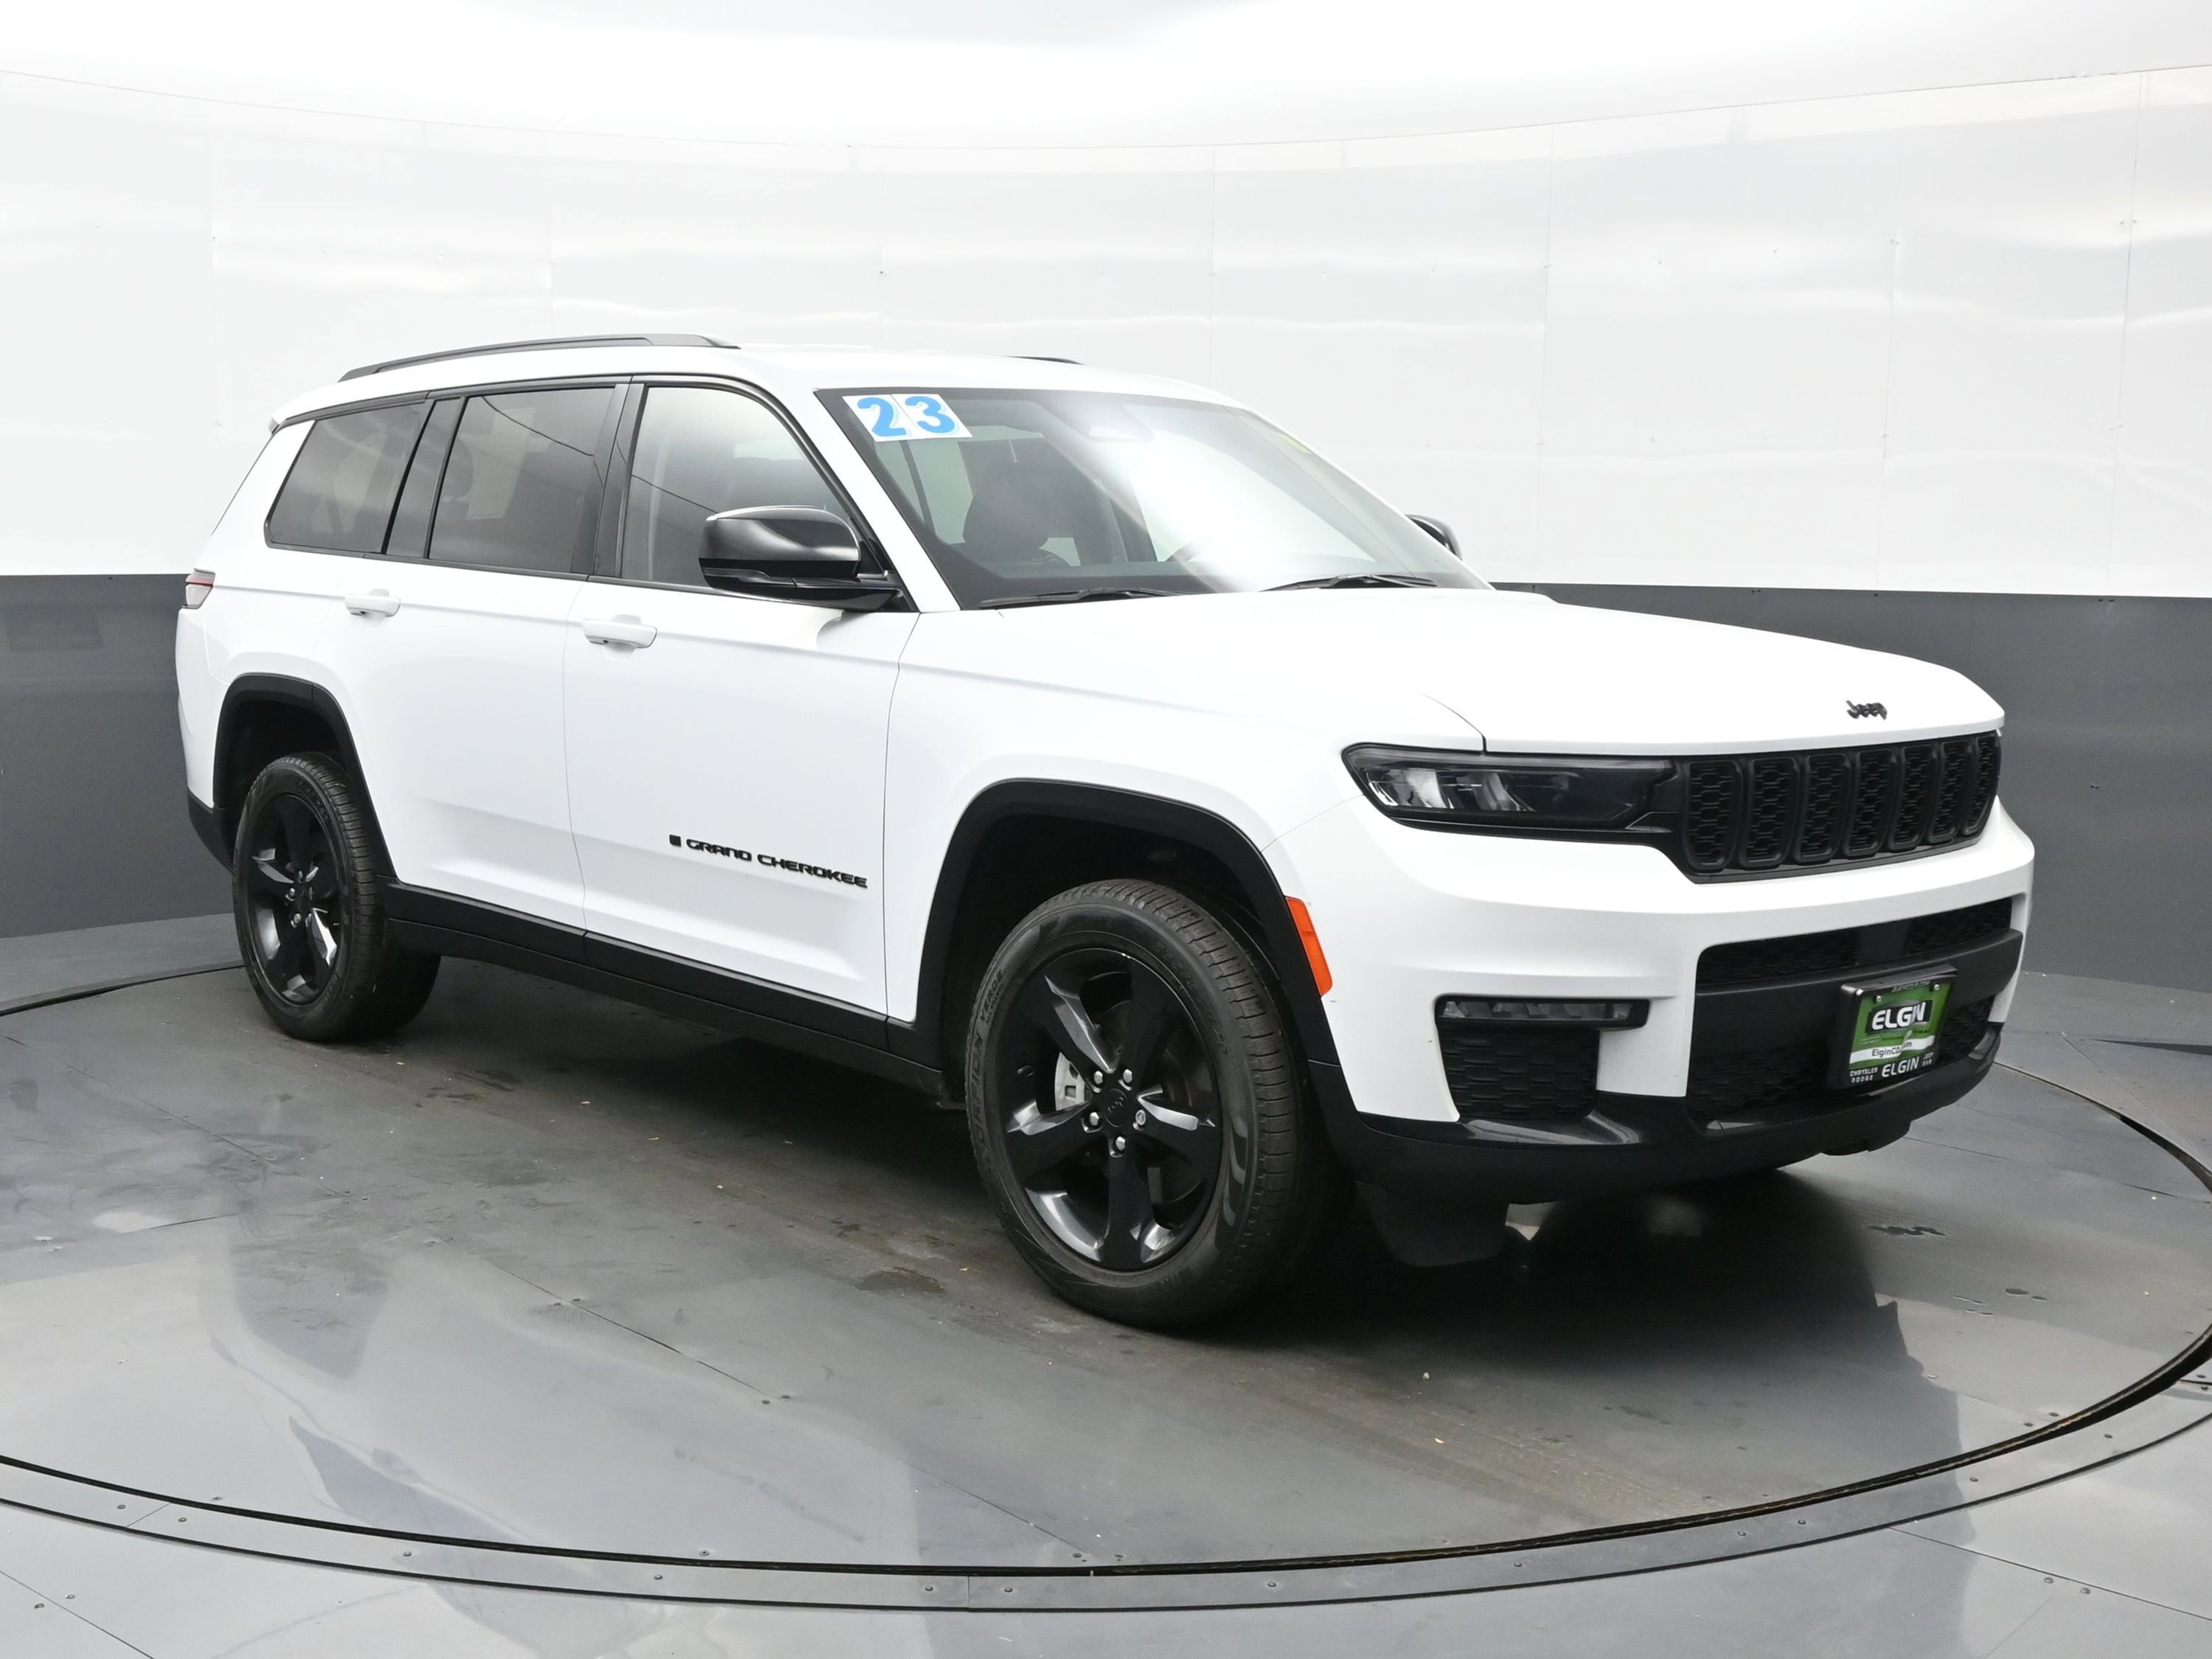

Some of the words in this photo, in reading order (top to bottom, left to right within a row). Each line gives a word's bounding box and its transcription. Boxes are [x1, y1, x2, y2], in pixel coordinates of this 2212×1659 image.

[858, 396, 955, 437] 23
[1846, 700, 1888, 720] Jeep
[686, 838, 752, 862] GRAND
[757, 854, 868, 888] CHEROKEE
[1871, 1001, 1926, 1030] ELGIN
[1881, 1057, 1920, 1077] ELGIN
